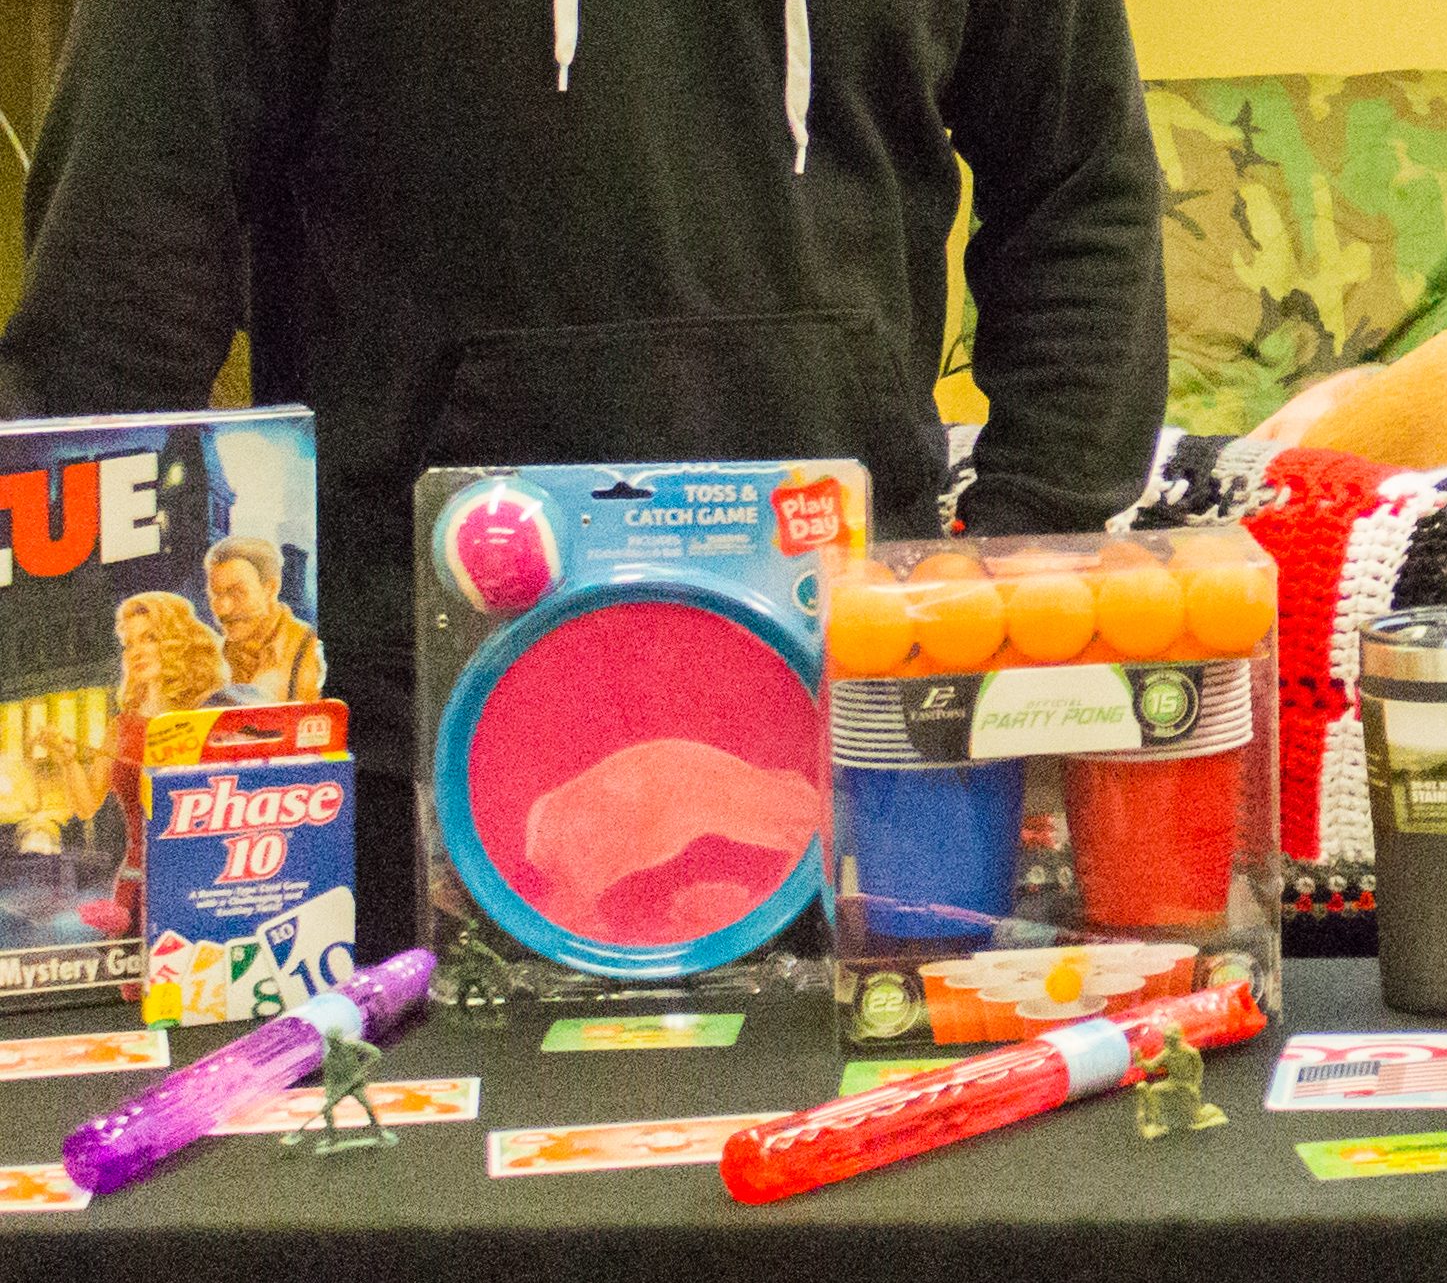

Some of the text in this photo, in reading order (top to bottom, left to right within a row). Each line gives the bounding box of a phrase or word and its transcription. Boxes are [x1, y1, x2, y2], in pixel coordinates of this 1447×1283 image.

[684, 485, 758, 503] TOSS &
[781, 494, 836, 520] Play
[0, 451, 160, 591] UE
[624, 507, 758, 526] CATCH GAME
[788, 515, 840, 543] Day
[1150, 692, 1179, 714] 15
[981, 704, 1126, 731] PARTY PONG
[165, 776, 343, 837] Phase
[216, 833, 287, 883] 10
[0, 948, 144, 989] Mystery Ga
[251, 976, 287, 1019] 8
[868, 994, 906, 1012] 22
